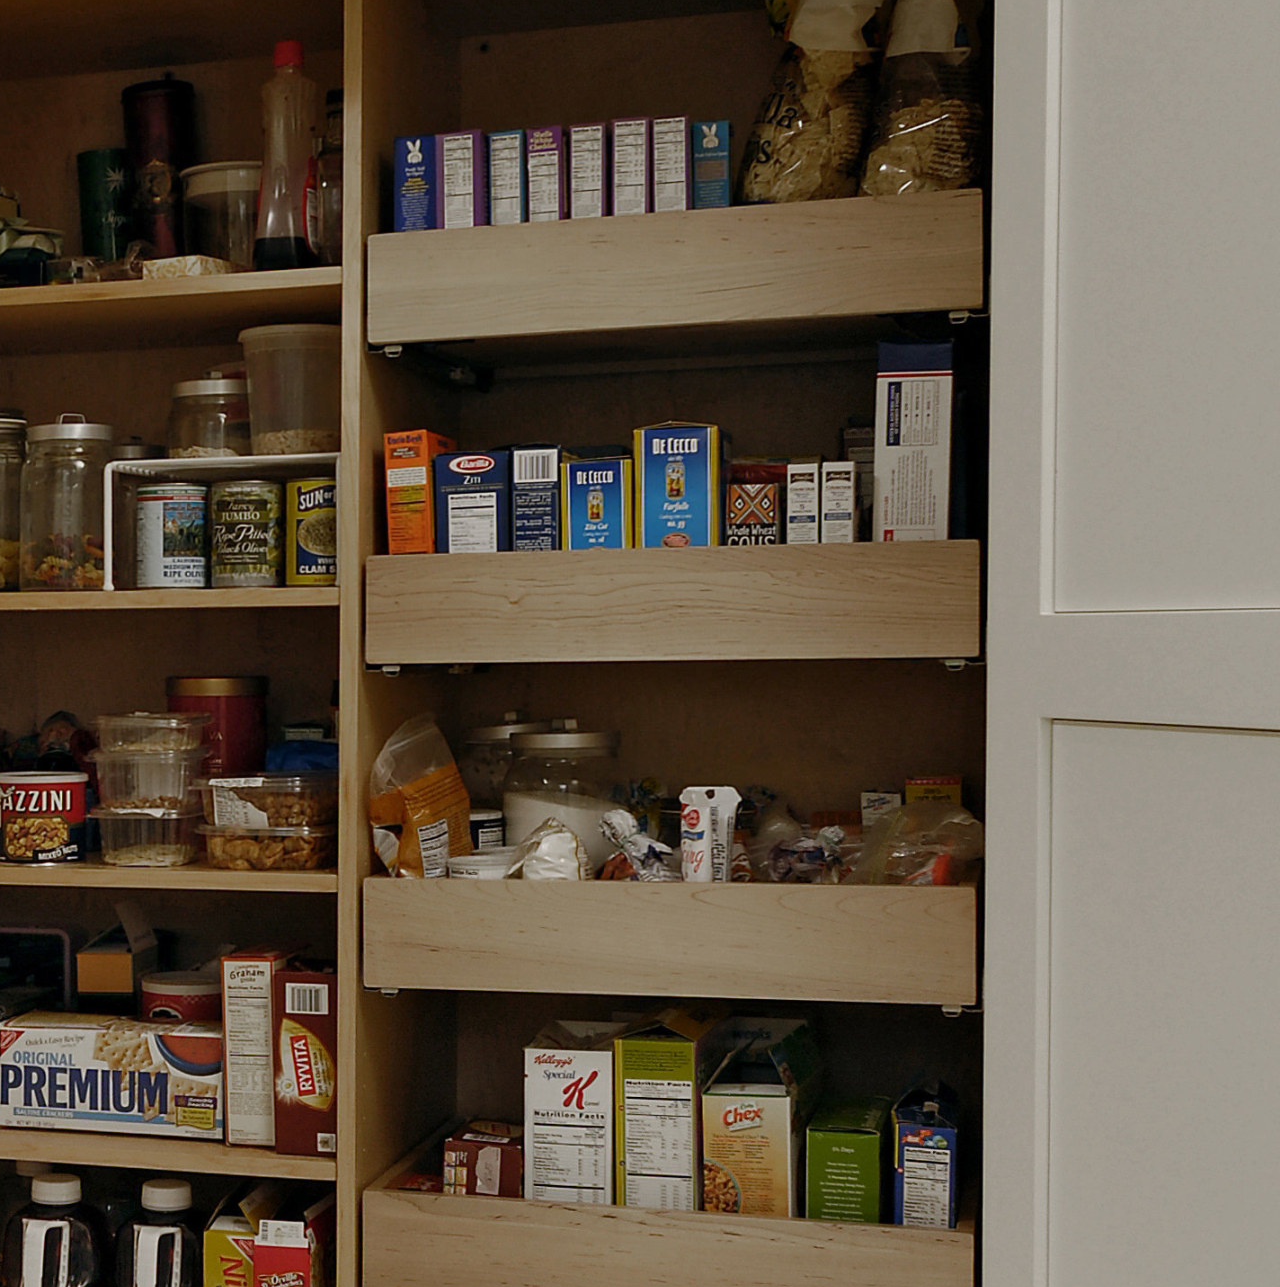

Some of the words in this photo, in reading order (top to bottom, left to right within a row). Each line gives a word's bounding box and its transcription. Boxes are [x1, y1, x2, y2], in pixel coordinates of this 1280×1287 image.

[652, 438, 667, 455] DE
[667, 437, 699, 454] CECCO
[576, 471, 588, 485] DE
[588, 470, 615, 484] CECCO
[299, 488, 324, 511] SUN
[220, 511, 260, 521] JUMBO
[727, 524, 750, 535] Whole
[751, 524, 776, 535] Wheat
[299, 565, 327, 574] CLAM
[37, 848, 62, 861] MIXED
[230, 969, 266, 980] Graham
[13, 1051, 75, 1066] ORIGINAL
[300, 1038, 314, 1092] RYVITA
[534, 1053, 573, 1068] Kellogg's
[543, 1069, 576, 1081] Special
[0, 1064, 168, 1115] PREMIUM
[563, 1070, 598, 1110] K
[534, 1110, 576, 1119] Nutrition
[579, 1111, 605, 1120] Facts
[723, 1107, 762, 1126] Chex
[271, 1272, 298, 1286] Orville
